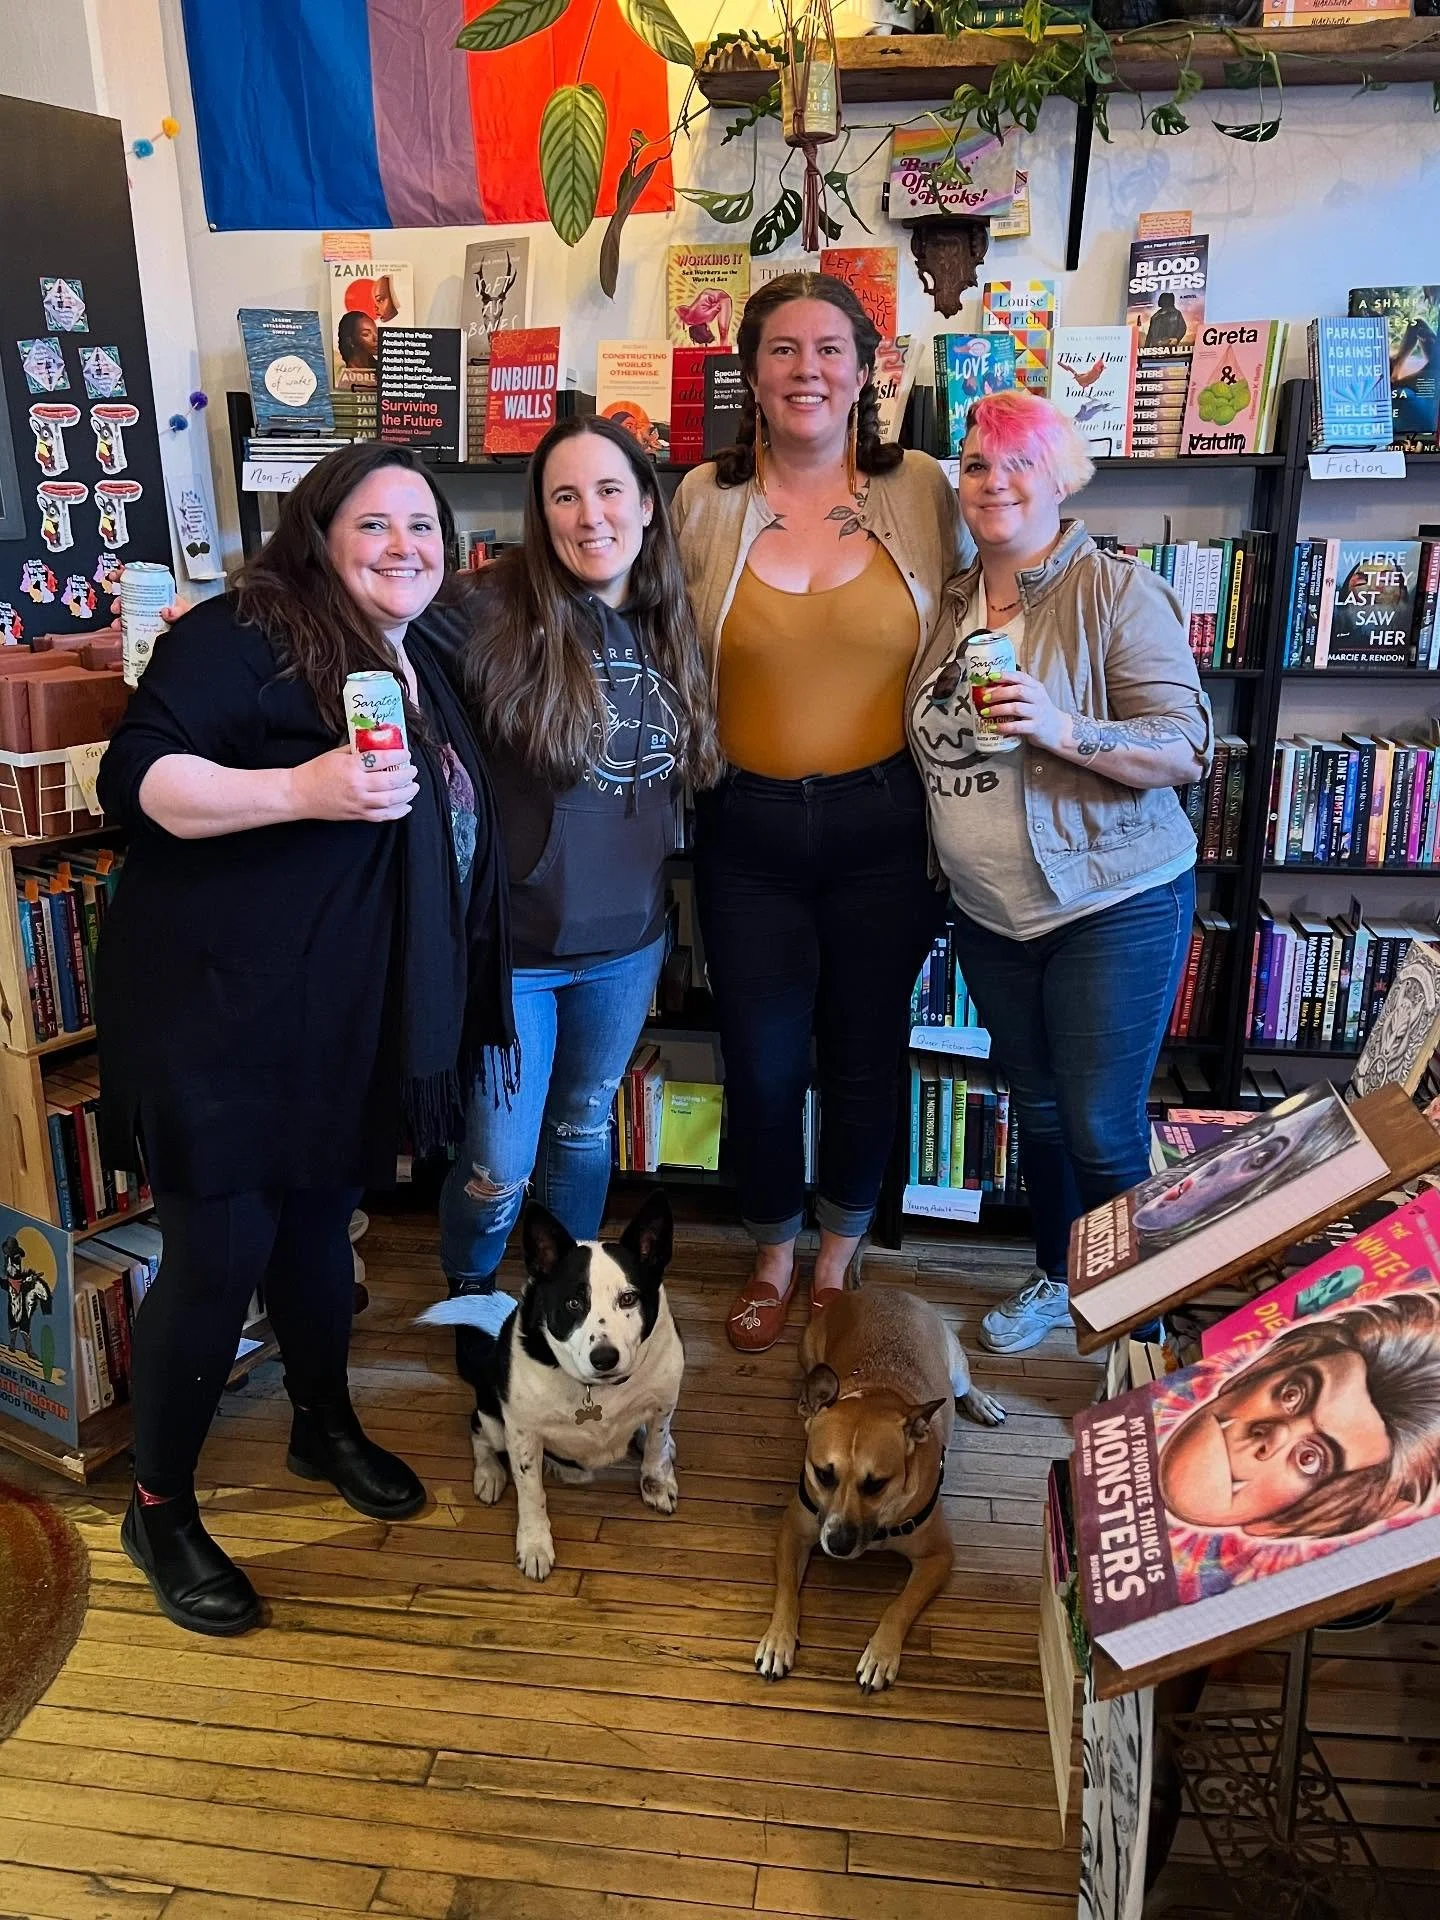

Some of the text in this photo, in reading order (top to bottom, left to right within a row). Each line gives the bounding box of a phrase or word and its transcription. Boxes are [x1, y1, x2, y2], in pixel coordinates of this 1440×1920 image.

[901, 158, 941, 172] Ban
[919, 189, 988, 206] Books!
[678, 254, 743, 266] WORKING IT
[826, 254, 853, 271] LET
[1136, 256, 1200, 278] BLOOD
[334, 264, 374, 278] ZAMI
[1128, 272, 1206, 294] SISTERS
[483, 299, 502, 316] AS
[854, 288, 893, 316] CALIZE
[999, 294, 1044, 308] Louise
[1358, 299, 1368, 308] A
[988, 312, 1041, 326] Erdrich
[382, 331, 432, 340] Abolish the Police
[1202, 327, 1258, 346] Greta
[1326, 327, 1384, 340] PARASOL
[1058, 350, 1127, 364] This Is How
[1137, 345, 1194, 356] ANESSA LILLI
[1328, 346, 1382, 359] AGAINST
[382, 357, 426, 365] Abolish Identity
[955, 352, 992, 380] LOVE
[382, 365, 432, 374] Abolish the Family
[610, 369, 660, 377] OTHERWISE
[1136, 370, 1163, 378] STERS
[1222, 365, 1236, 385] &
[1328, 364, 1382, 377] THE AXE
[342, 373, 376, 382] AUDRE
[382, 374, 451, 382] Abolish Racial Capitalism
[491, 364, 555, 392] UNBUILD
[1018, 374, 1048, 382] ntence
[272, 376, 281, 396] of
[382, 382, 403, 390] Abolish
[878, 380, 898, 399] ish
[1065, 387, 1115, 398] You Lose
[382, 400, 438, 414] Surviving
[504, 394, 552, 420] WALLS
[1134, 396, 1160, 406] STERS
[1132, 410, 1158, 419] STERS
[1336, 404, 1378, 417] HELEN
[356, 418, 377, 428] ZAM
[382, 414, 442, 428] the Future
[1102, 422, 1126, 432] War
[356, 430, 377, 439] ZAM
[1331, 423, 1385, 436] OYEYEMI
[1190, 432, 1246, 452] Valdin
[1325, 455, 1388, 474] Fiction
[250, 468, 302, 484] Non-Fic
[1302, 546, 1310, 560] The
[1342, 551, 1407, 566] WHERE
[1197, 555, 1207, 580] BAD
[1210, 554, 1220, 580] BAD
[1364, 572, 1414, 587] THEY
[1296, 584, 1306, 610] Pickers
[1335, 591, 1380, 606] LAST
[1356, 610, 1396, 626] SAW
[1370, 630, 1406, 646] HER
[1328, 654, 1359, 662] MARCIE
[1369, 654, 1405, 662] RENDON
[925, 770, 1000, 798] CLUB
[1214, 761, 1224, 796] OBELISK
[1332, 753, 1349, 824] LONE WOMEN
[1190, 784, 1200, 817] SEASON
[1301, 1002, 1309, 1017] Mike
[1300, 1018, 1306, 1027] Fu
[1313, 1019, 1320, 1028] Fu
[924, 1099, 936, 1174] MONSTROUS AFFECTIONS
[906, 1200, 928, 1214] Young
[1388, 1221, 1414, 1240] THE
[1086, 1202, 1115, 1277] MONSTERS
[1352, 1232, 1410, 1278] WHITE
[1254, 1302, 1292, 1332] DIE
[0, 1365, 46, 1395] ERE FOR A
[0, 1391, 20, 1406] OOD
[22, 1400, 46, 1420] TIME
[1129, 1416, 1166, 1584] MY FAVORITE THING IS
[1092, 1414, 1146, 1602] MONSTERS
[1092, 1580, 1104, 1604] TWO
